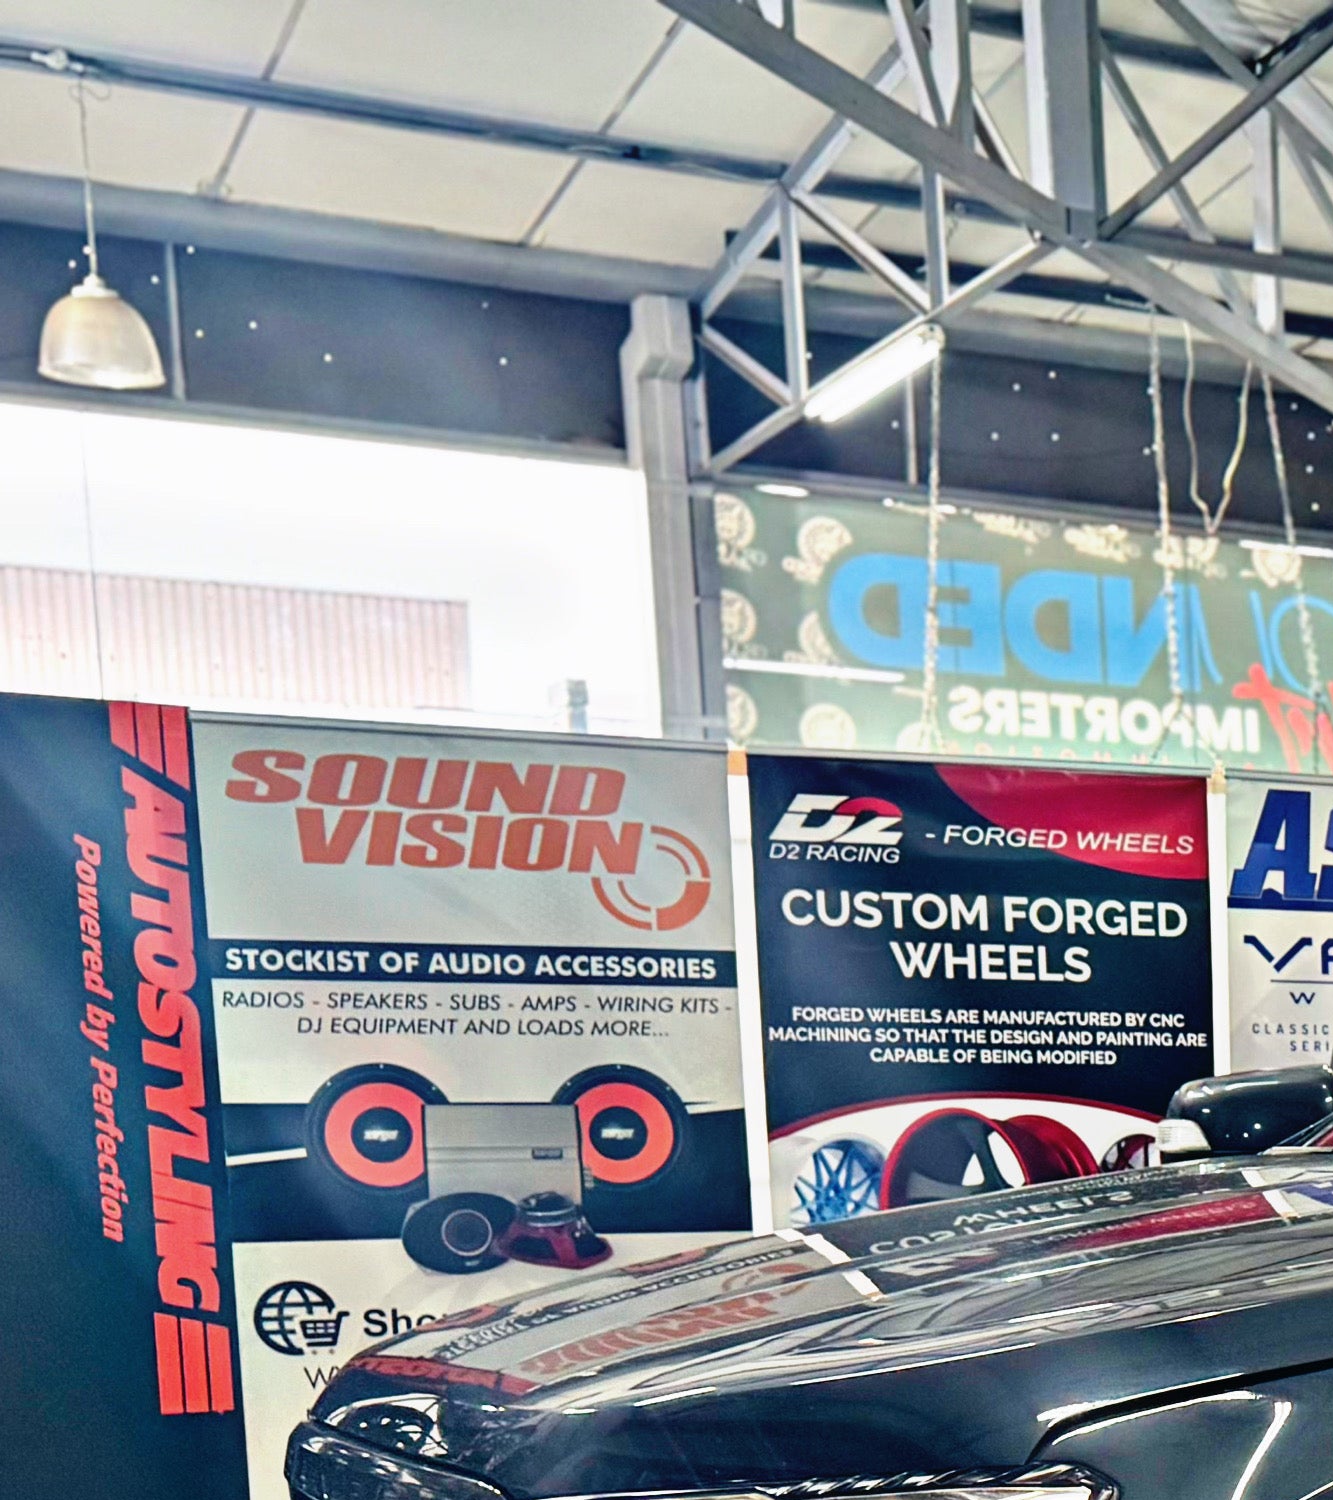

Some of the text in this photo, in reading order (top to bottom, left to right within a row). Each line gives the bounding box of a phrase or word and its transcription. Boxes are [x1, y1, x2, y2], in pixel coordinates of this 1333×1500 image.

[224, 748, 627, 817] SOUND
[769, 793, 904, 846] D2
[295, 807, 644, 875] VISION
[769, 844, 901, 864] D2 RACING
[943, 824, 1068, 850] FORGED
[1077, 831, 1194, 855] WHEELS
[72, 833, 114, 1000] Powered
[781, 888, 1188, 938] CUSTOM FORGED
[225, 947, 718, 981] STOCKIST OF AUDIO ACCESSORIES
[889, 940, 1092, 984] WHEELS
[222, 990, 305, 1009] RADIOS
[327, 991, 428, 1011] SPEAKERS
[449, 993, 501, 1012] SUBS
[521, 995, 578, 1012] AMPS
[597, 996, 675, 1014] WIRING
[681, 997, 720, 1015] KITS
[792, 1006, 1185, 1028] FORGED WHEELS ARE MANUFACTURED BY CNC
[80, 1002, 117, 1052] by
[120, 764, 221, 1313] AUTOSTYLING
[298, 1017, 669, 1037] DJ EQUIPMENT AND LOADS MORE...
[769, 1026, 1208, 1048] MACHINING SO THAT THE DESIGN AND PAINTING ARE
[1251, 1022, 1331, 1035] CLASSIC
[870, 1048, 1117, 1066] CAPABLE OF BEING MODIFIED
